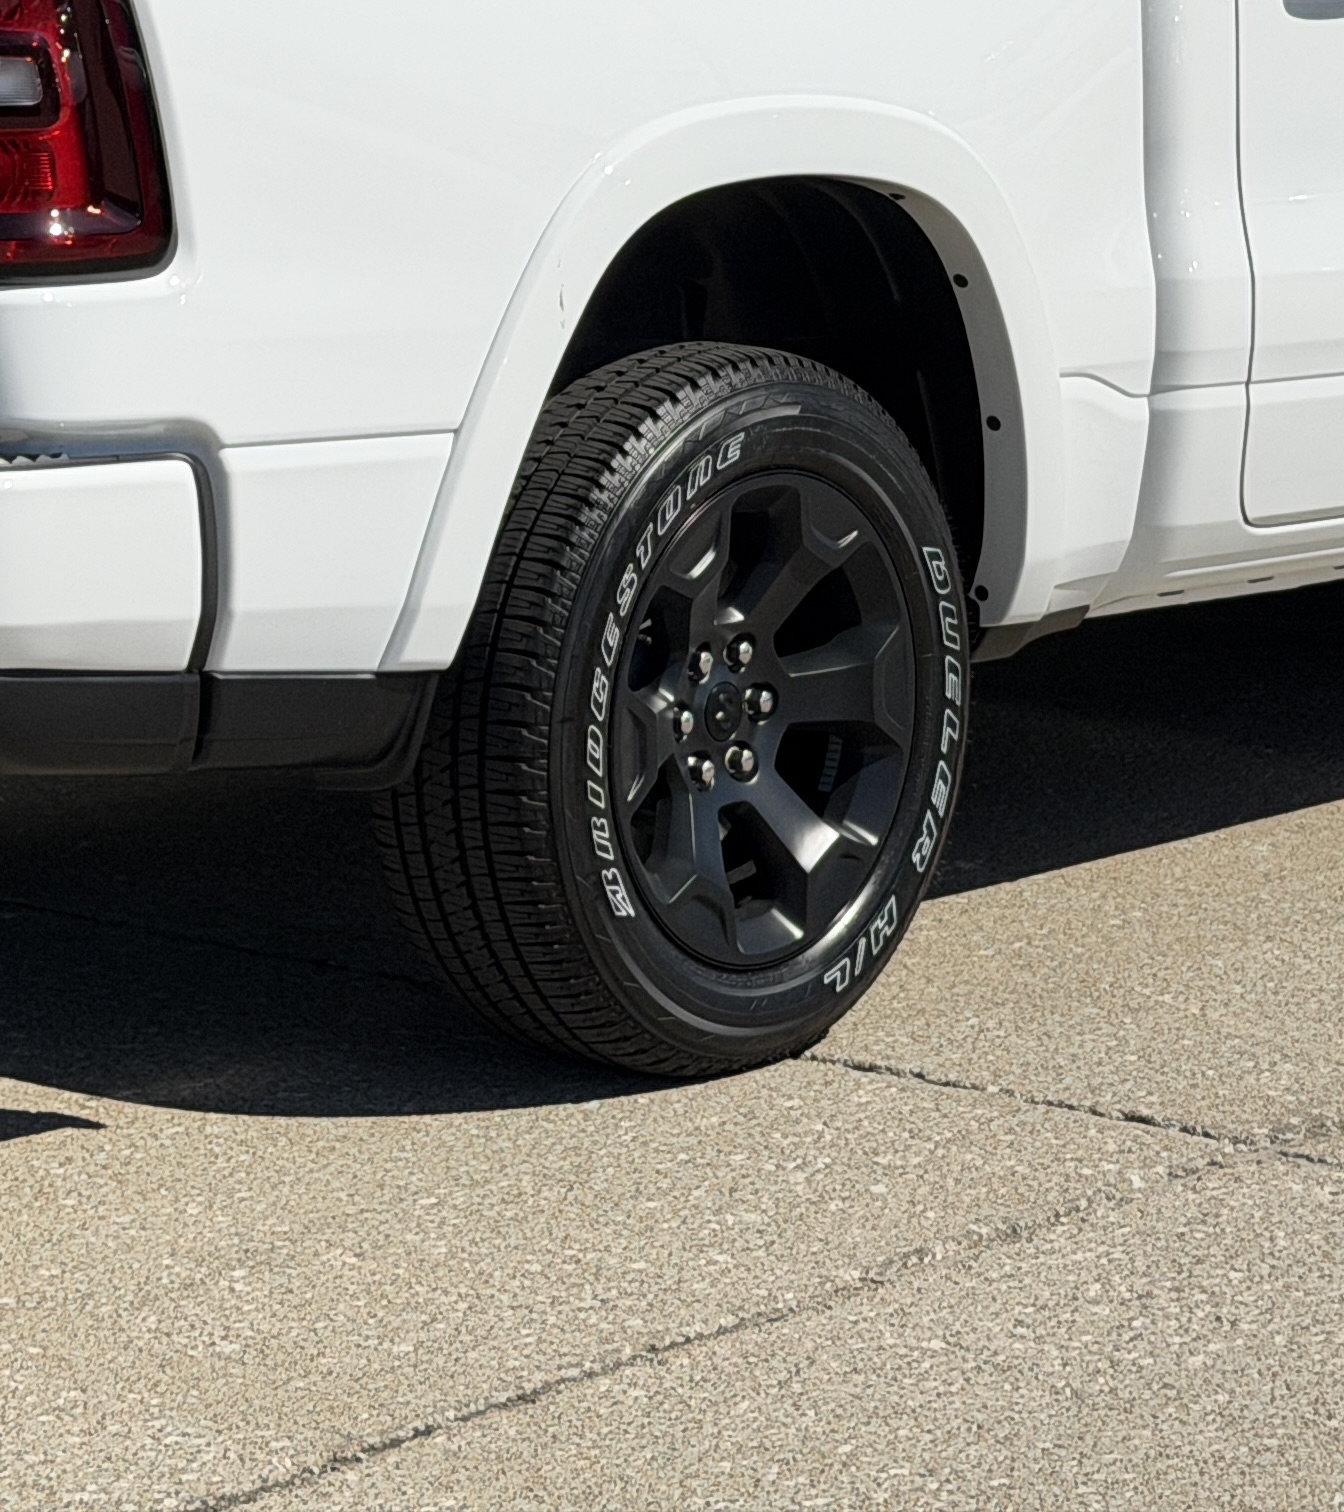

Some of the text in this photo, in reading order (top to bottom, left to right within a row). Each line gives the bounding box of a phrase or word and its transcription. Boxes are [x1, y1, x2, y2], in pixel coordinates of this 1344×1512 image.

[587, 431, 746, 918] BRIDGESTONE
[824, 545, 962, 992] DUELER H/L
